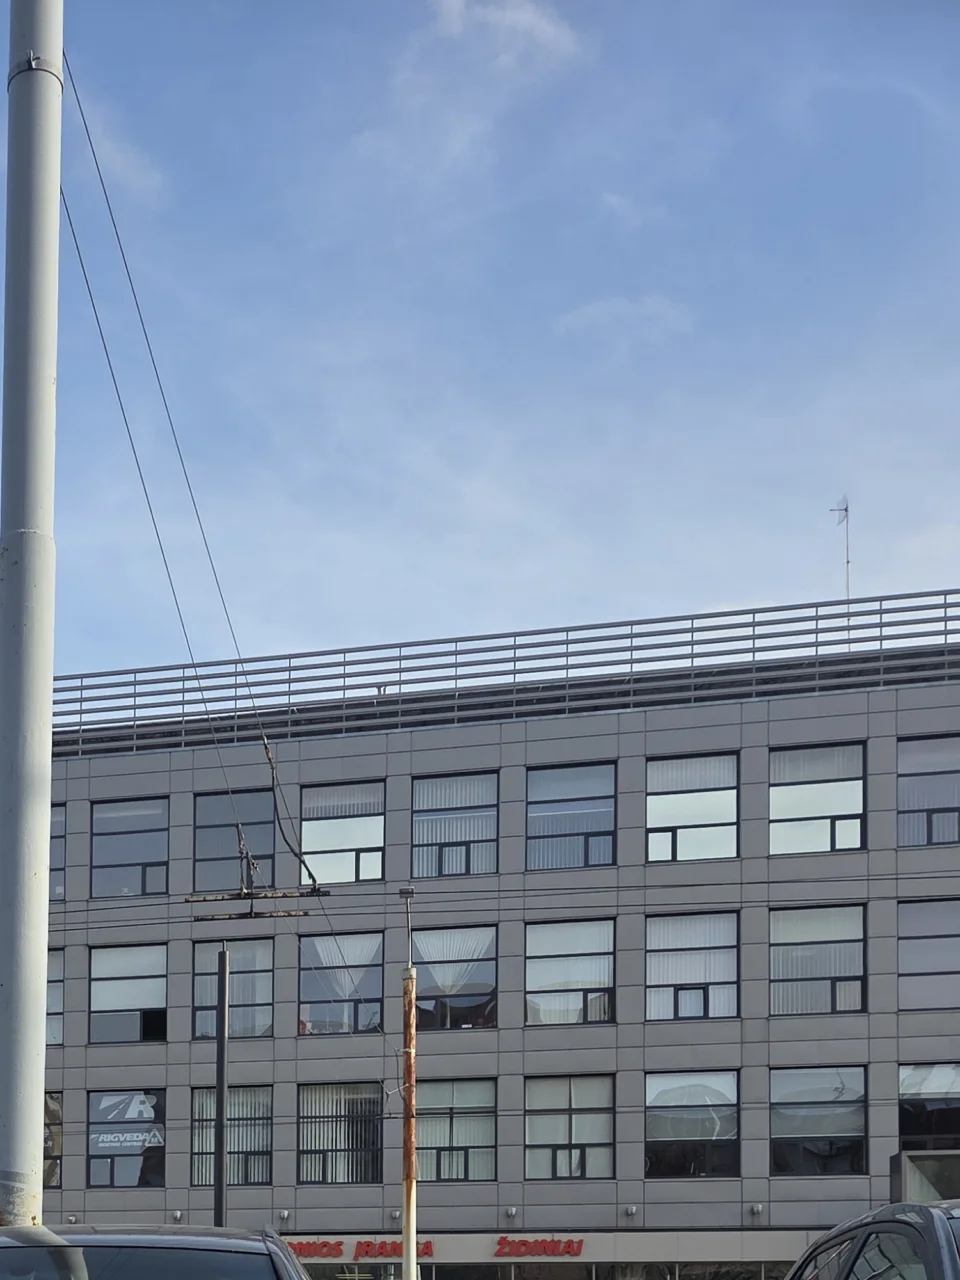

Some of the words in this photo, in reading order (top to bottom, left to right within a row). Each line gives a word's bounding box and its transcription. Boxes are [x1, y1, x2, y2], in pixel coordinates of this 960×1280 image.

[98, 1132, 150, 1142] RIGVEDA
[287, 1240, 345, 1258] NIOS
[352, 1240, 435, 1262] ĮRANA
[494, 1235, 585, 1258] ŽIDINIAI
